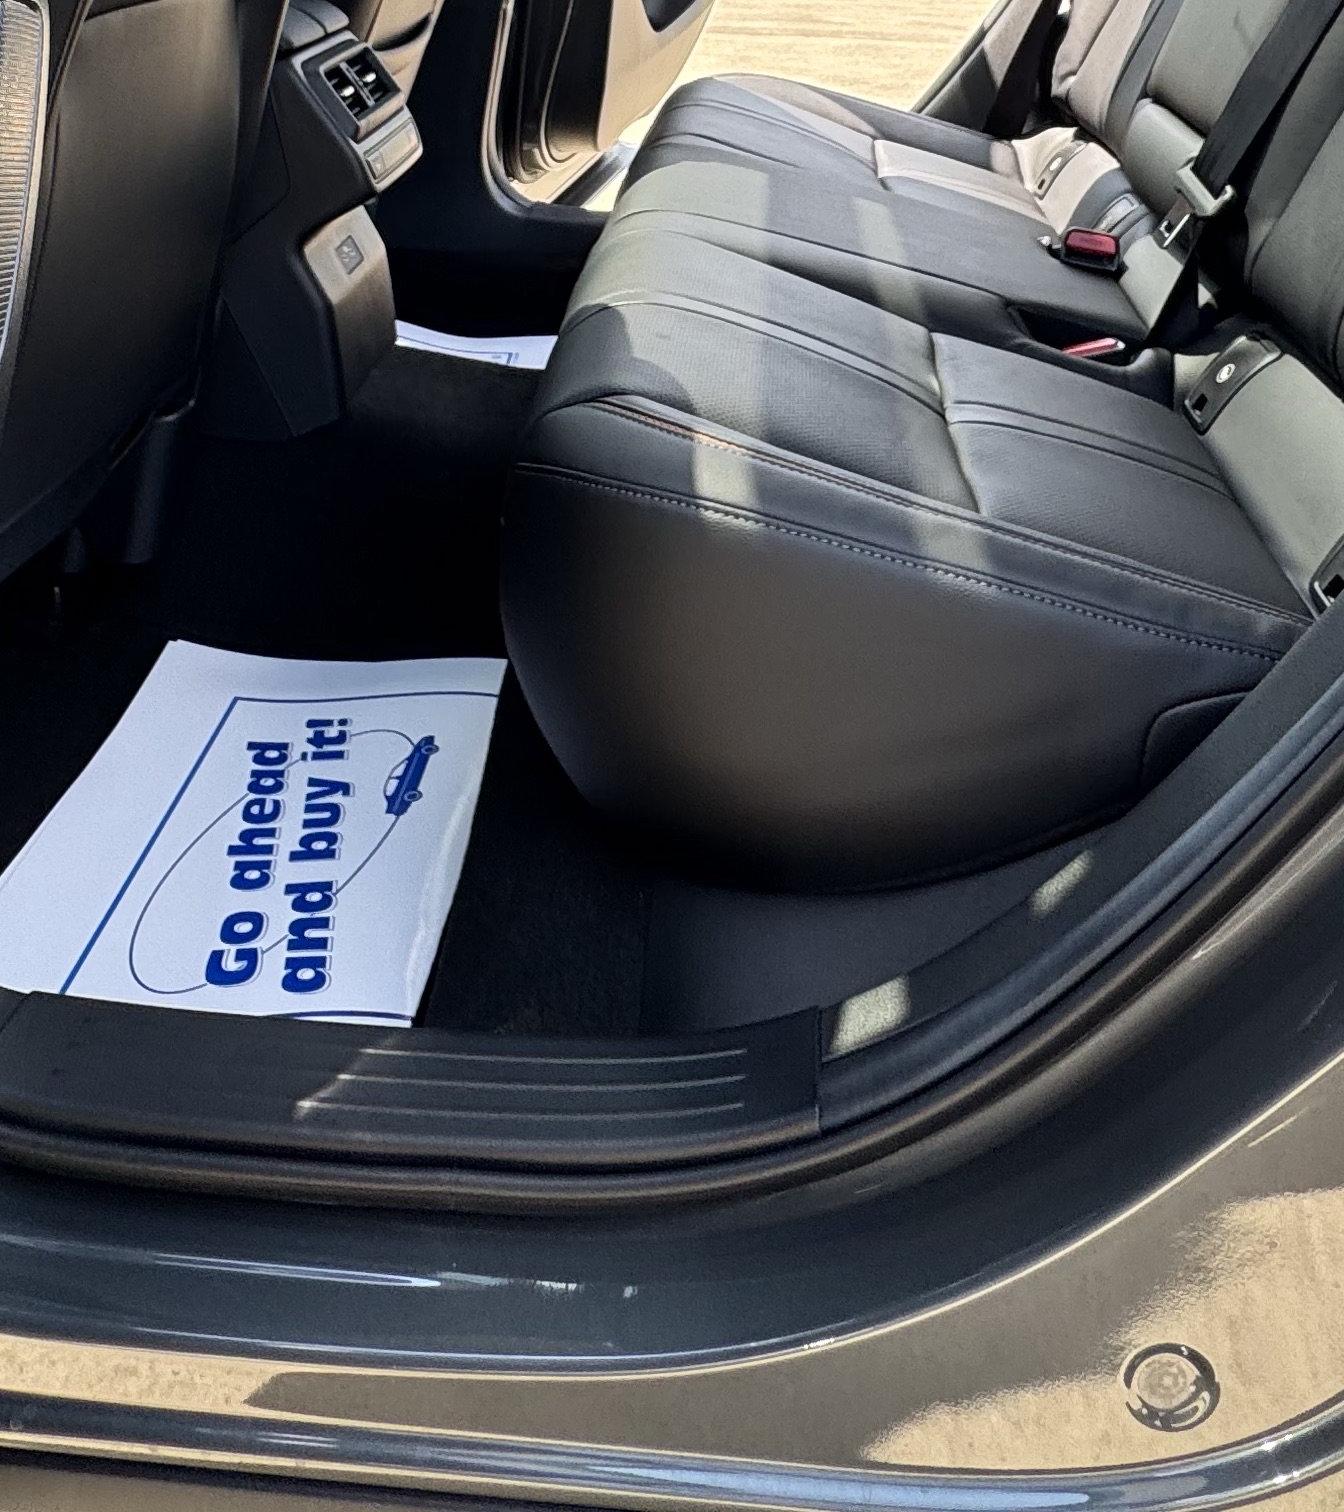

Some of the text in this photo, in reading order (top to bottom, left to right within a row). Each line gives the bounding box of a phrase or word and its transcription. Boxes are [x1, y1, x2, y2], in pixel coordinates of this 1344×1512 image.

[205, 740, 293, 987] Go ahead
[281, 718, 356, 995] and buy it!
